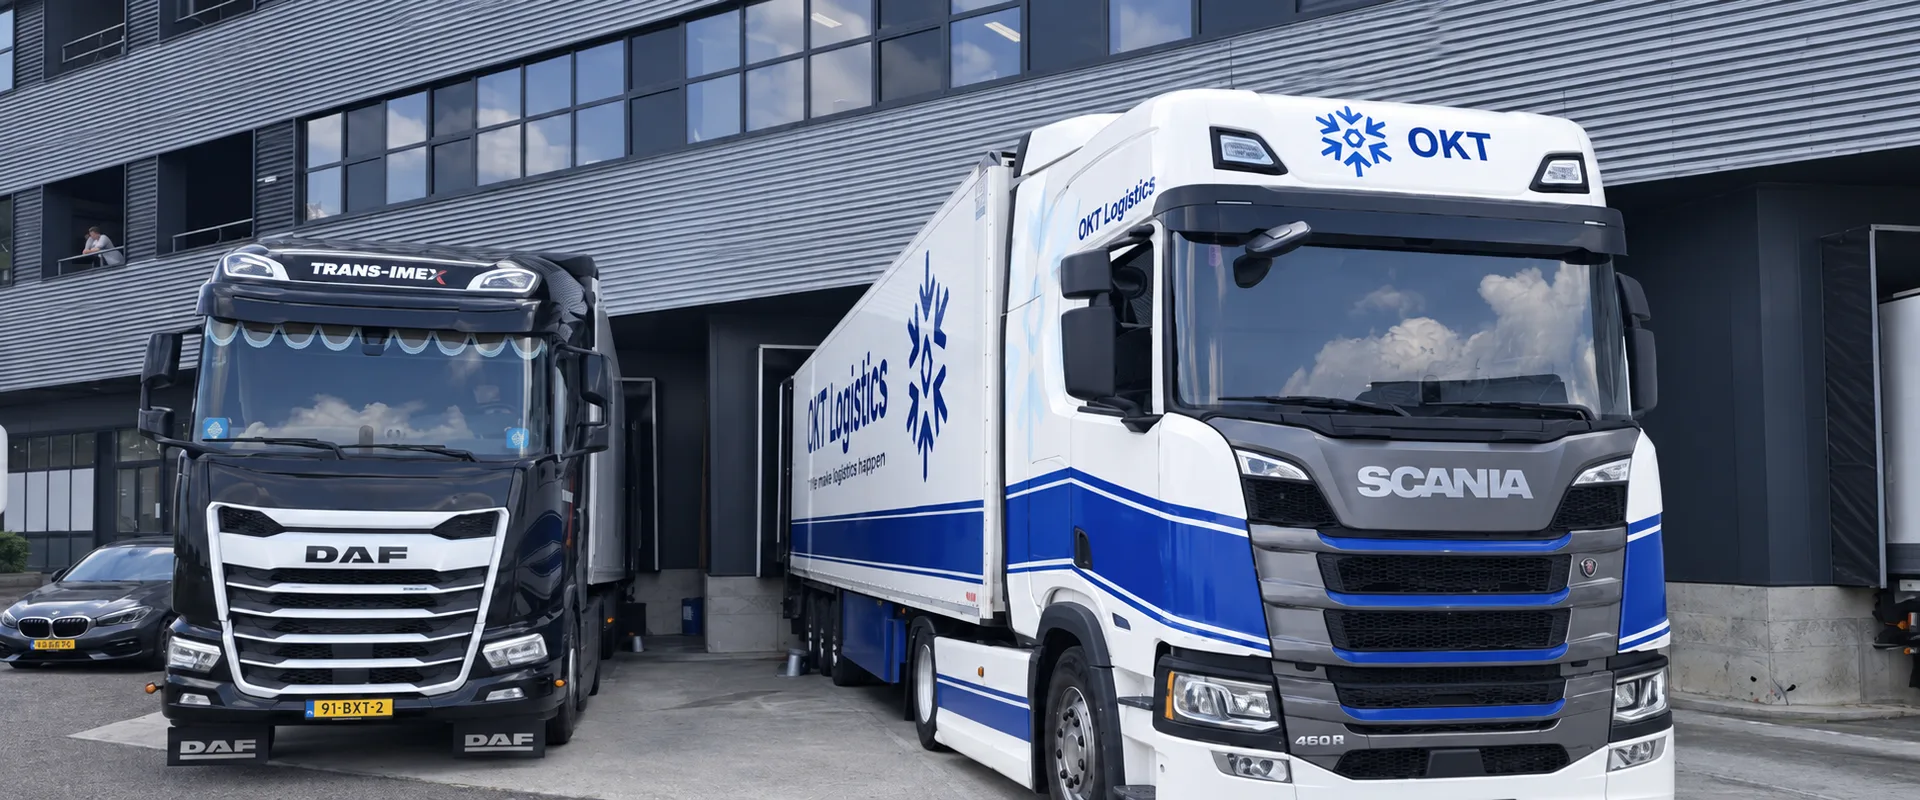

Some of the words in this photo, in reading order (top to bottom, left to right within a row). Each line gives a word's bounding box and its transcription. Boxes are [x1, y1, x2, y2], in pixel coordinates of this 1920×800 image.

[1408, 127, 1491, 161] OKT
[1078, 207, 1102, 241] OKT
[1104, 176, 1156, 225] Logistics
[311, 262, 447, 285] TRANS-IMEX
[807, 387, 827, 454] OKT
[829, 351, 888, 454] Logistics
[832, 461, 857, 486] logistics
[858, 451, 886, 476] happen
[1357, 465, 1534, 499] SCANIA
[305, 545, 408, 564] DAF
[321, 701, 384, 715] 91-BXT-2
[180, 739, 256, 754] DAF
[464, 733, 534, 747] DAF
